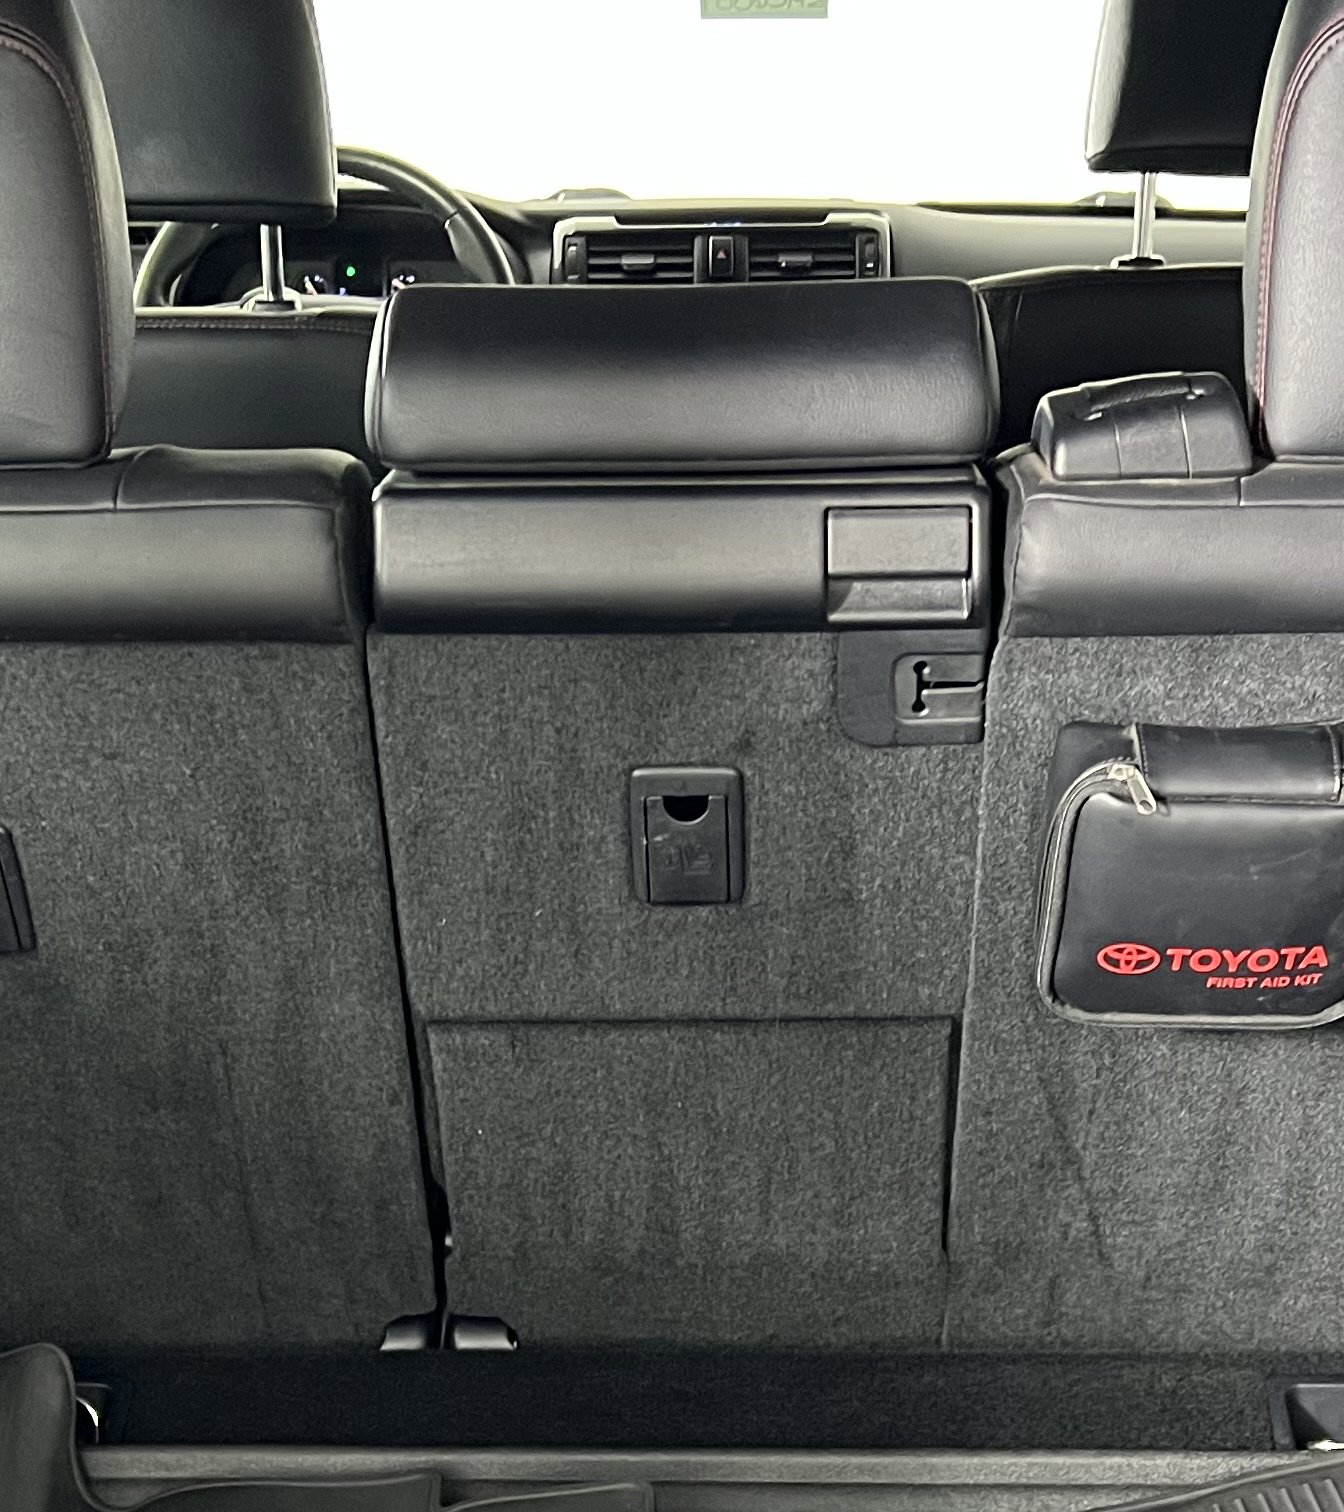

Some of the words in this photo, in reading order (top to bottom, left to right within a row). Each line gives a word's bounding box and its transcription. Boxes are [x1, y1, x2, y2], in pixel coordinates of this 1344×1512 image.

[1166, 945, 1329, 973] TOYOTA
[1206, 976, 1258, 989] FIRST
[1259, 975, 1291, 988] AID
[1294, 973, 1323, 987] KIT
